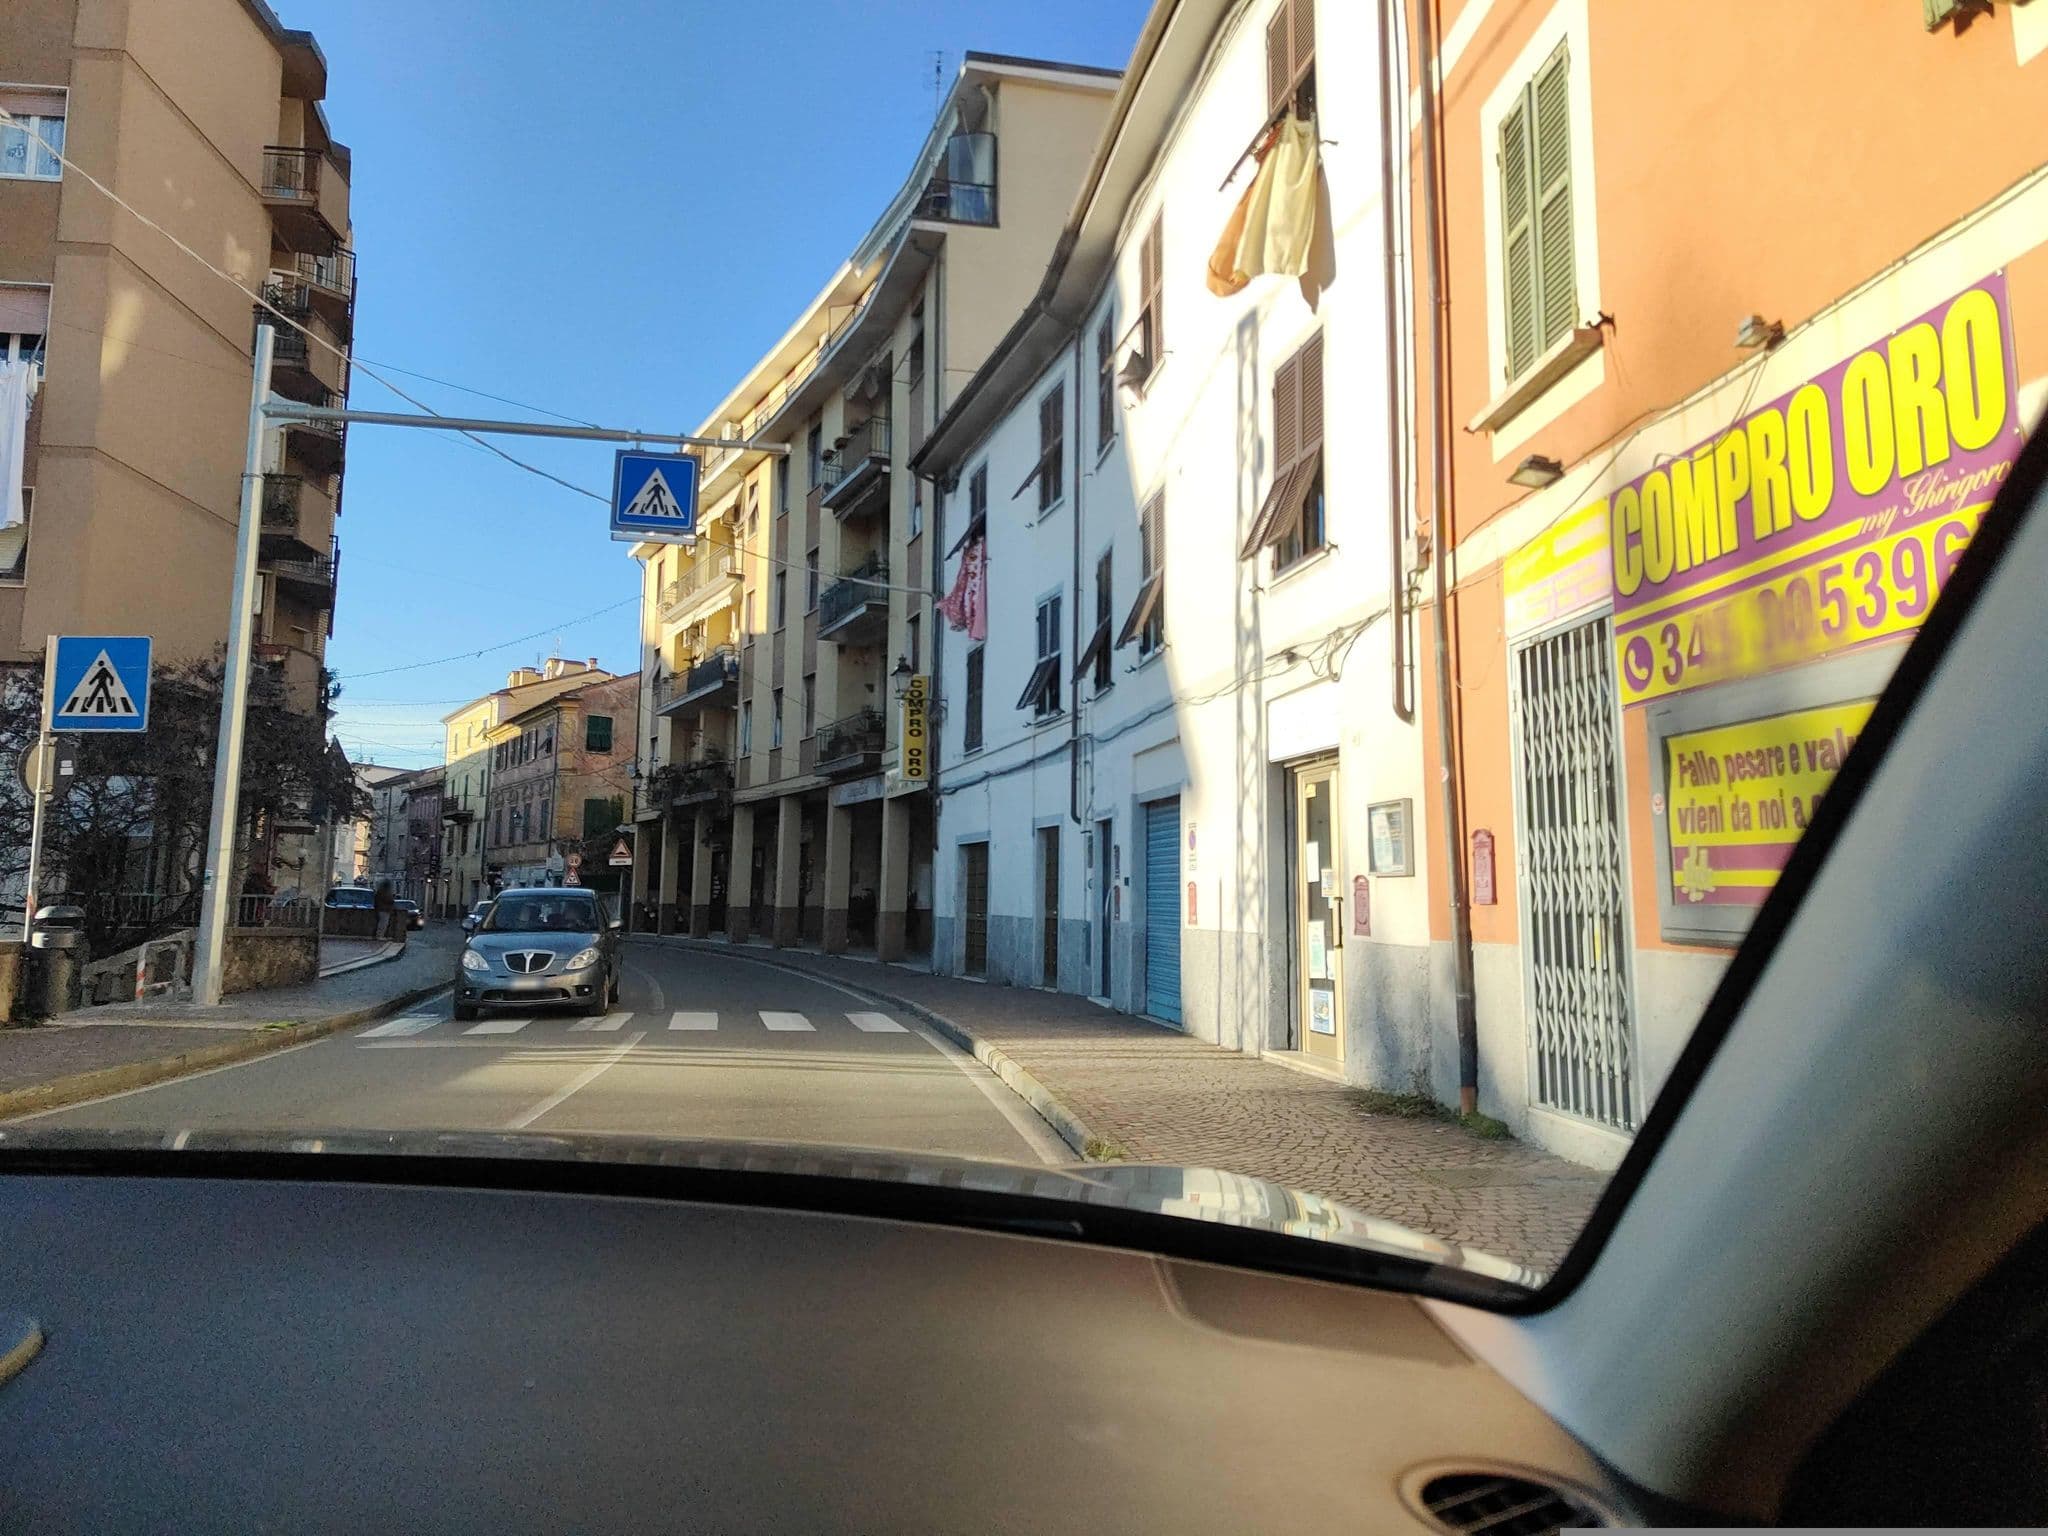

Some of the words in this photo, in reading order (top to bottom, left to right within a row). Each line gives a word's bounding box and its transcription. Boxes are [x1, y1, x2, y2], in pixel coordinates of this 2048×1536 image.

[1613, 383, 1834, 596] COMPRO
[1841, 288, 2007, 496] ORO
[1860, 505, 1898, 539] my
[908, 680, 923, 737] COMPRO
[908, 748, 922, 777] ORO
[1677, 750, 1721, 788] Fallo
[1724, 745, 1785, 791] pesare
[1789, 742, 1800, 775] e
[1677, 794, 1725, 835] vieni
[1731, 794, 1752, 832] da
[1759, 788, 1788, 830] noi
